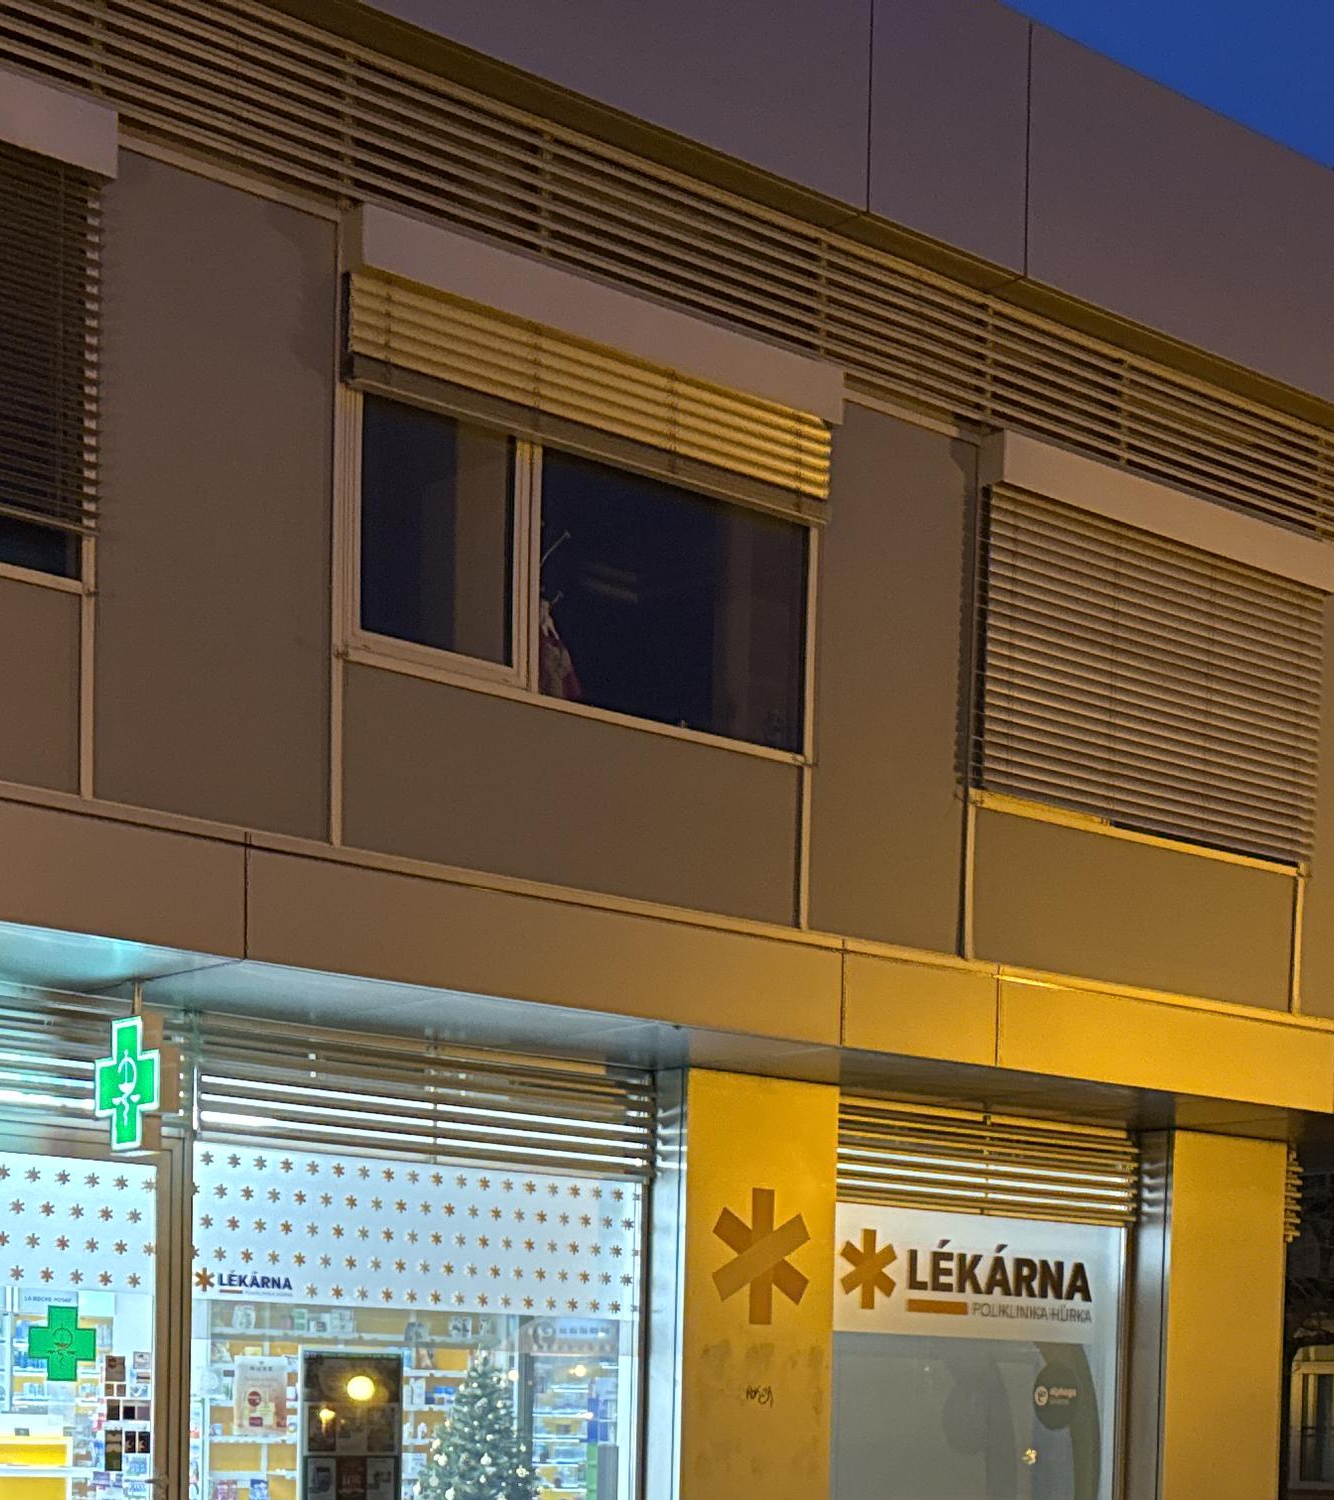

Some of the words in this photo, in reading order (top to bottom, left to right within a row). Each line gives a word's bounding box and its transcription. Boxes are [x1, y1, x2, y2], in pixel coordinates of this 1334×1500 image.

[218, 1269, 293, 1290] LÉKÁRNA
[907, 1239, 1092, 1302] LÉKÁRNA
[972, 1302, 1048, 1321] POLIKLINIKA
